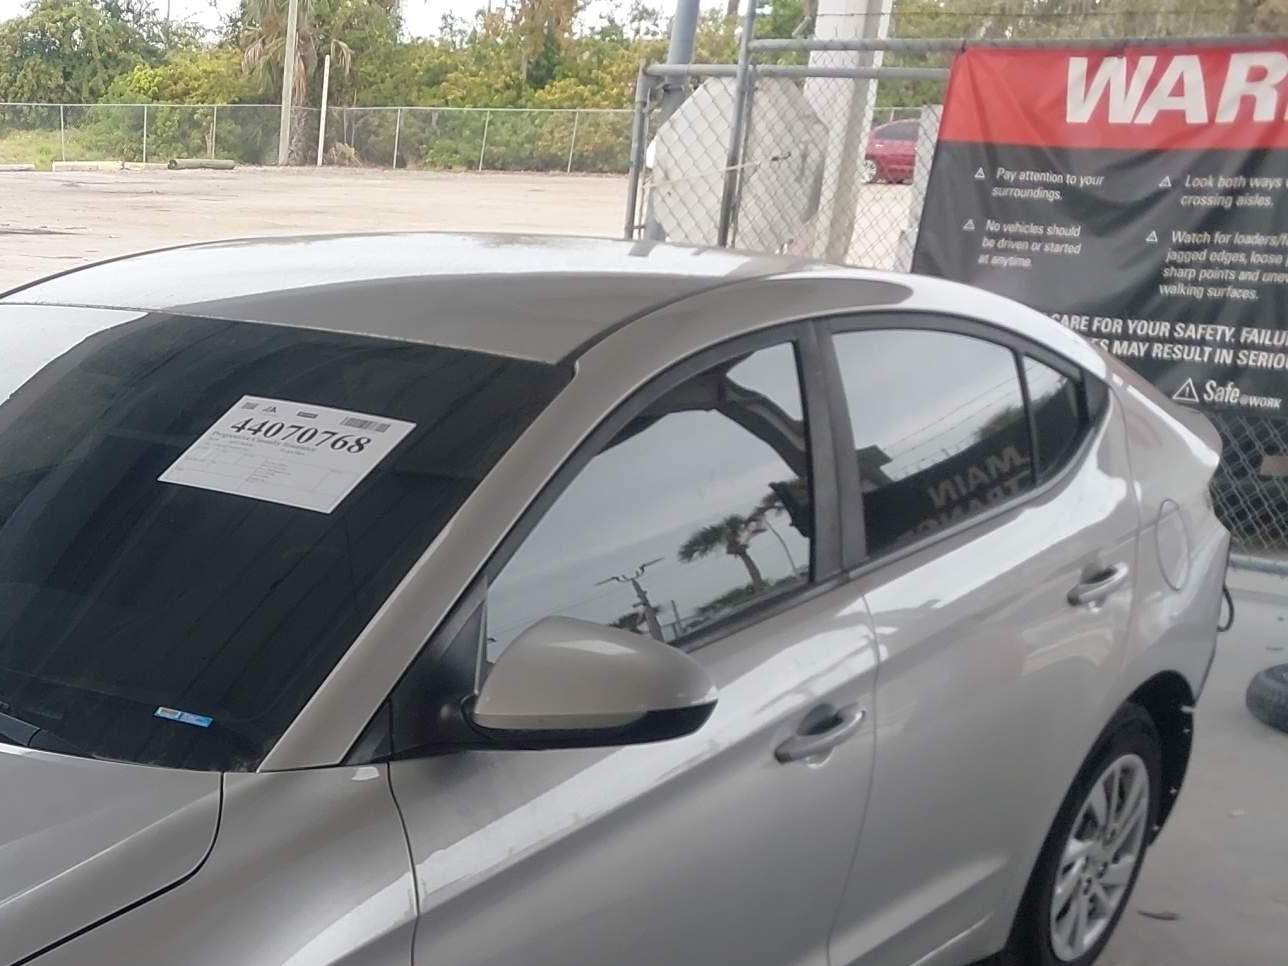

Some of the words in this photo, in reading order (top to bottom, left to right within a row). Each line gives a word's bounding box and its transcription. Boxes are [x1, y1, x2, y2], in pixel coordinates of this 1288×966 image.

[1066, 52, 1288, 124] WAR
[996, 167, 1016, 182] Pay
[1019, 170, 1063, 184] attention
[1066, 173, 1077, 185] to
[1080, 175, 1104, 187] your
[1185, 175, 1213, 188] Look
[1218, 175, 1246, 188] both
[1250, 177, 1282, 190] ways
[992, 187, 1063, 202] surroundings.
[1180, 193, 1233, 209] crossing
[1236, 193, 1274, 207] aisles.
[986, 220, 1000, 232] No
[1003, 221, 1044, 235] vehicles
[1047, 224, 1081, 237] should
[1172, 230, 1211, 244] Watch
[1214, 231, 1232, 244] for
[982, 236, 994, 248] be
[997, 238, 1028, 251] driven
[1031, 241, 1042, 252] or
[1044, 242, 1081, 255] started
[978, 255, 989, 265] at
[1165, 248, 1207, 263] jagged
[1250, 251, 1283, 264] loose
[1163, 266, 1196, 280] sharp
[1199, 267, 1236, 281] points
[1239, 269, 1260, 281] and
[1159, 283, 1204, 299] walking
[1207, 286, 1259, 300] surfaces.
[1093, 317, 1123, 334] FOR
[1128, 319, 1170, 338] YOUR
[1174, 322, 1235, 342] SAFETY.
[1112, 339, 1149, 358] MAY
[1152, 343, 1212, 362] RESULT
[1214, 348, 1233, 365] IN
[1236, 350, 1288, 369] SERIO
[231, 416, 372, 454] 44070768
